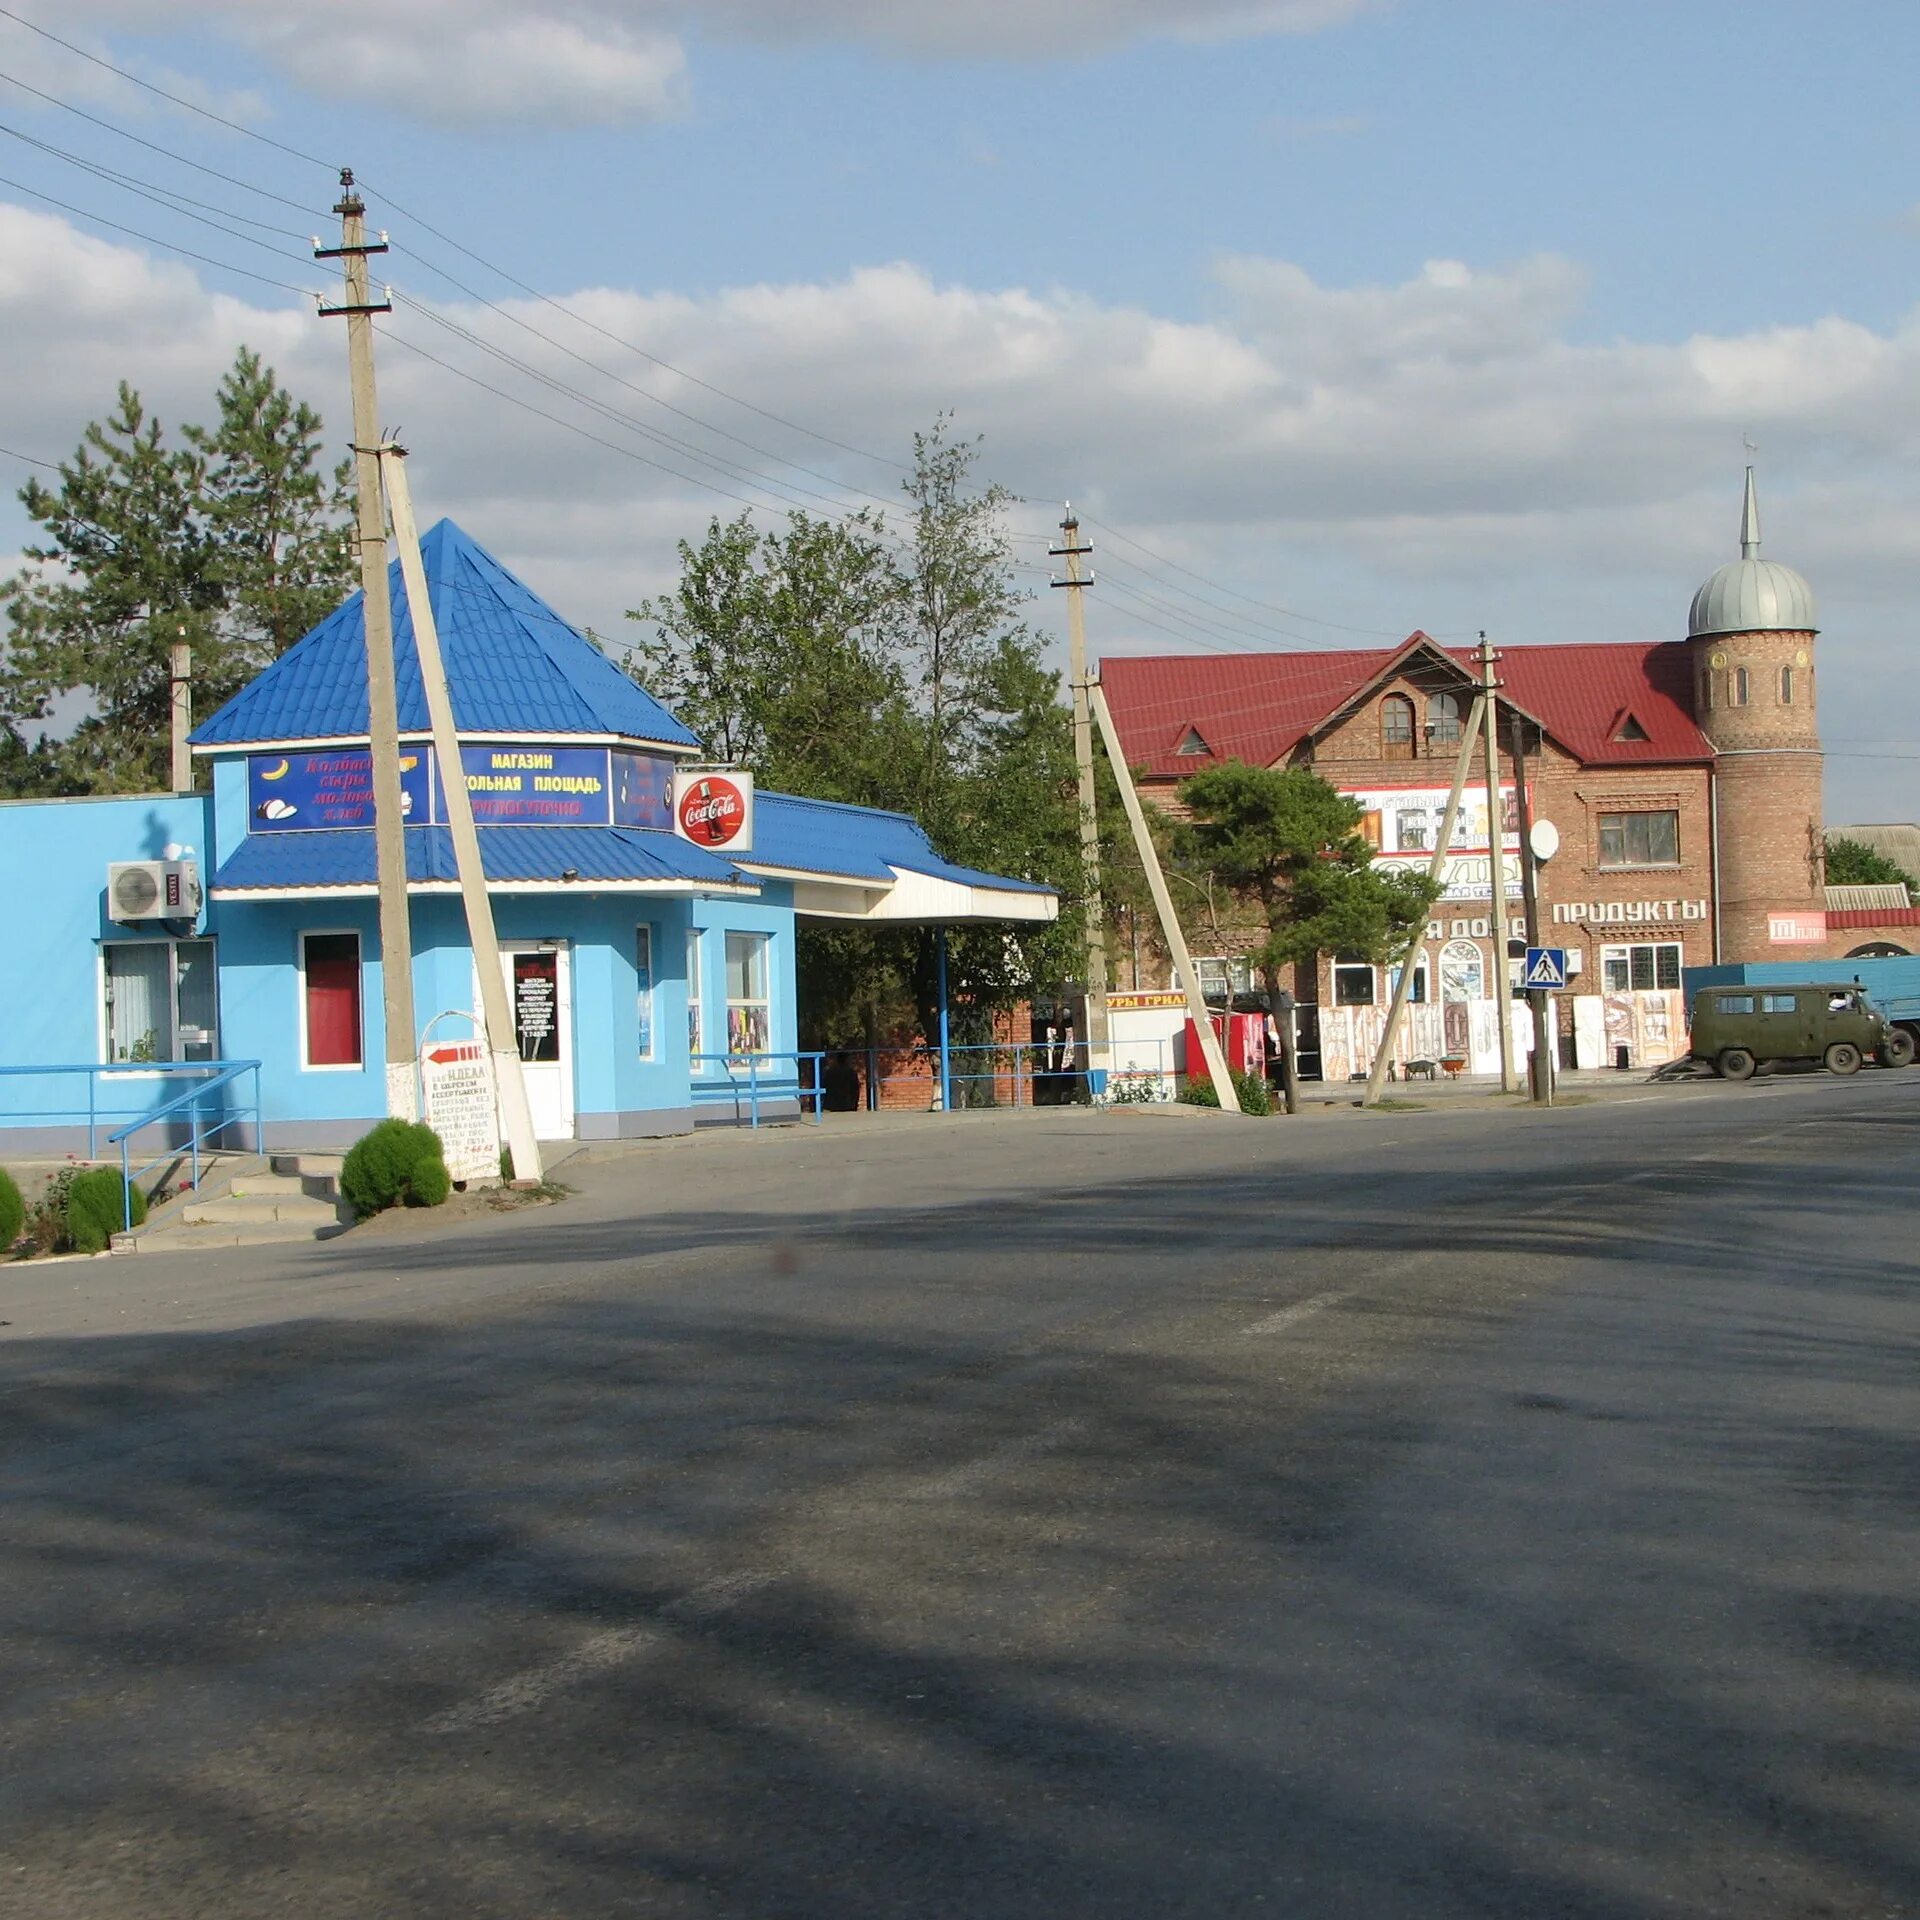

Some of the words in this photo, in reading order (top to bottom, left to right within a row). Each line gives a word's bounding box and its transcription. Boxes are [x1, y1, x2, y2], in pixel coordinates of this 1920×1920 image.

[305, 755, 374, 774] Колбас
[491, 753, 553, 770] МАГАЗИН
[534, 776, 602, 795] ПЛОЩАДЬ
[471, 800, 584, 817] РУГЛОСУТОЧНО
[685, 793, 736, 828] Coca-Cola
[1407, 813, 1476, 828] котоые
[1374, 857, 1523, 885] ОТЛЫ
[1552, 900, 1707, 924] ПРОДУКТЫ
[1449, 916, 1527, 940] ДОА
[1106, 996, 1139, 1008] УРЫ
